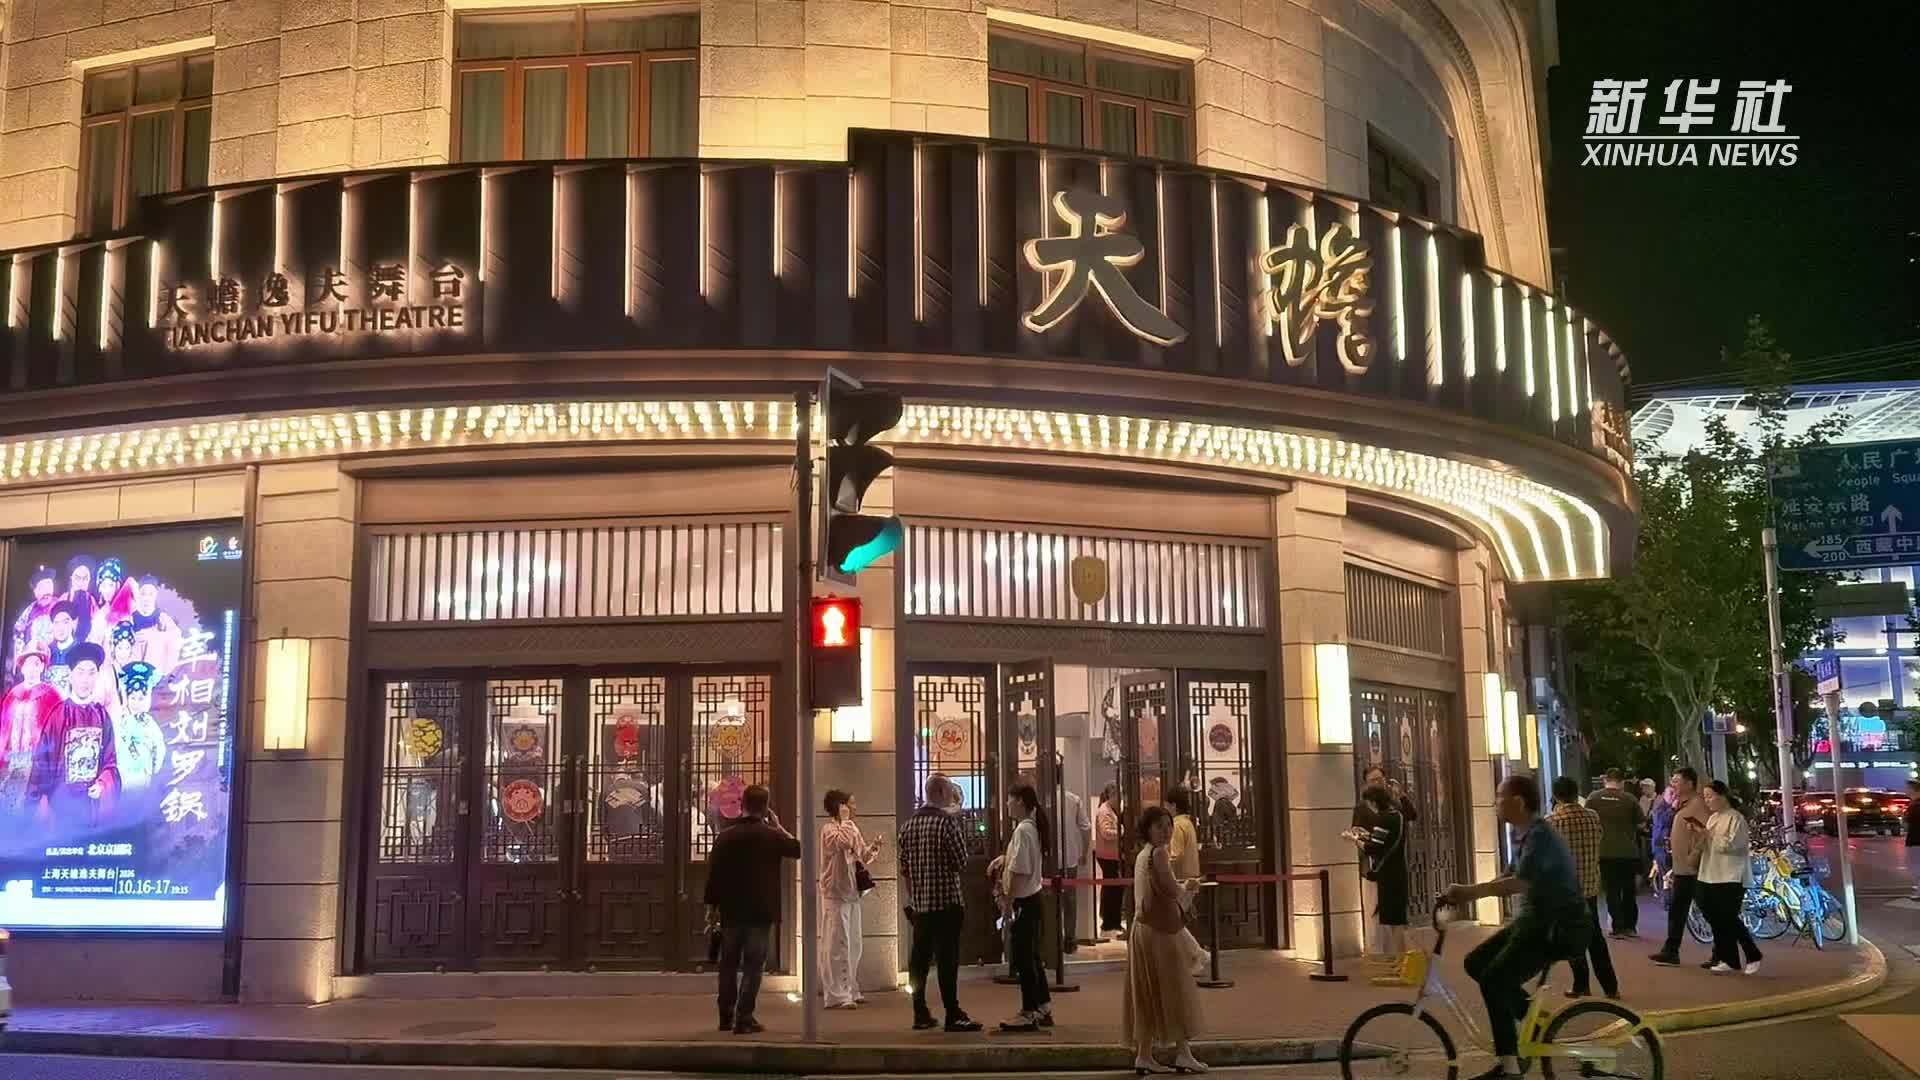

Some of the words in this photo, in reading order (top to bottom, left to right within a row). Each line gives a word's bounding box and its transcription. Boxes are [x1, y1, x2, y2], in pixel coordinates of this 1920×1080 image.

[159, 263, 465, 320] 天蟾逸夫舞台
[280, 309, 337, 336] YIFU
[343, 304, 463, 331] THEATRE
[1821, 534, 1842, 545] 185
[1822, 551, 1846, 562] 200
[160, 627, 218, 822] 宰相刘罗锅
[118, 879, 171, 895] 10.16-17
